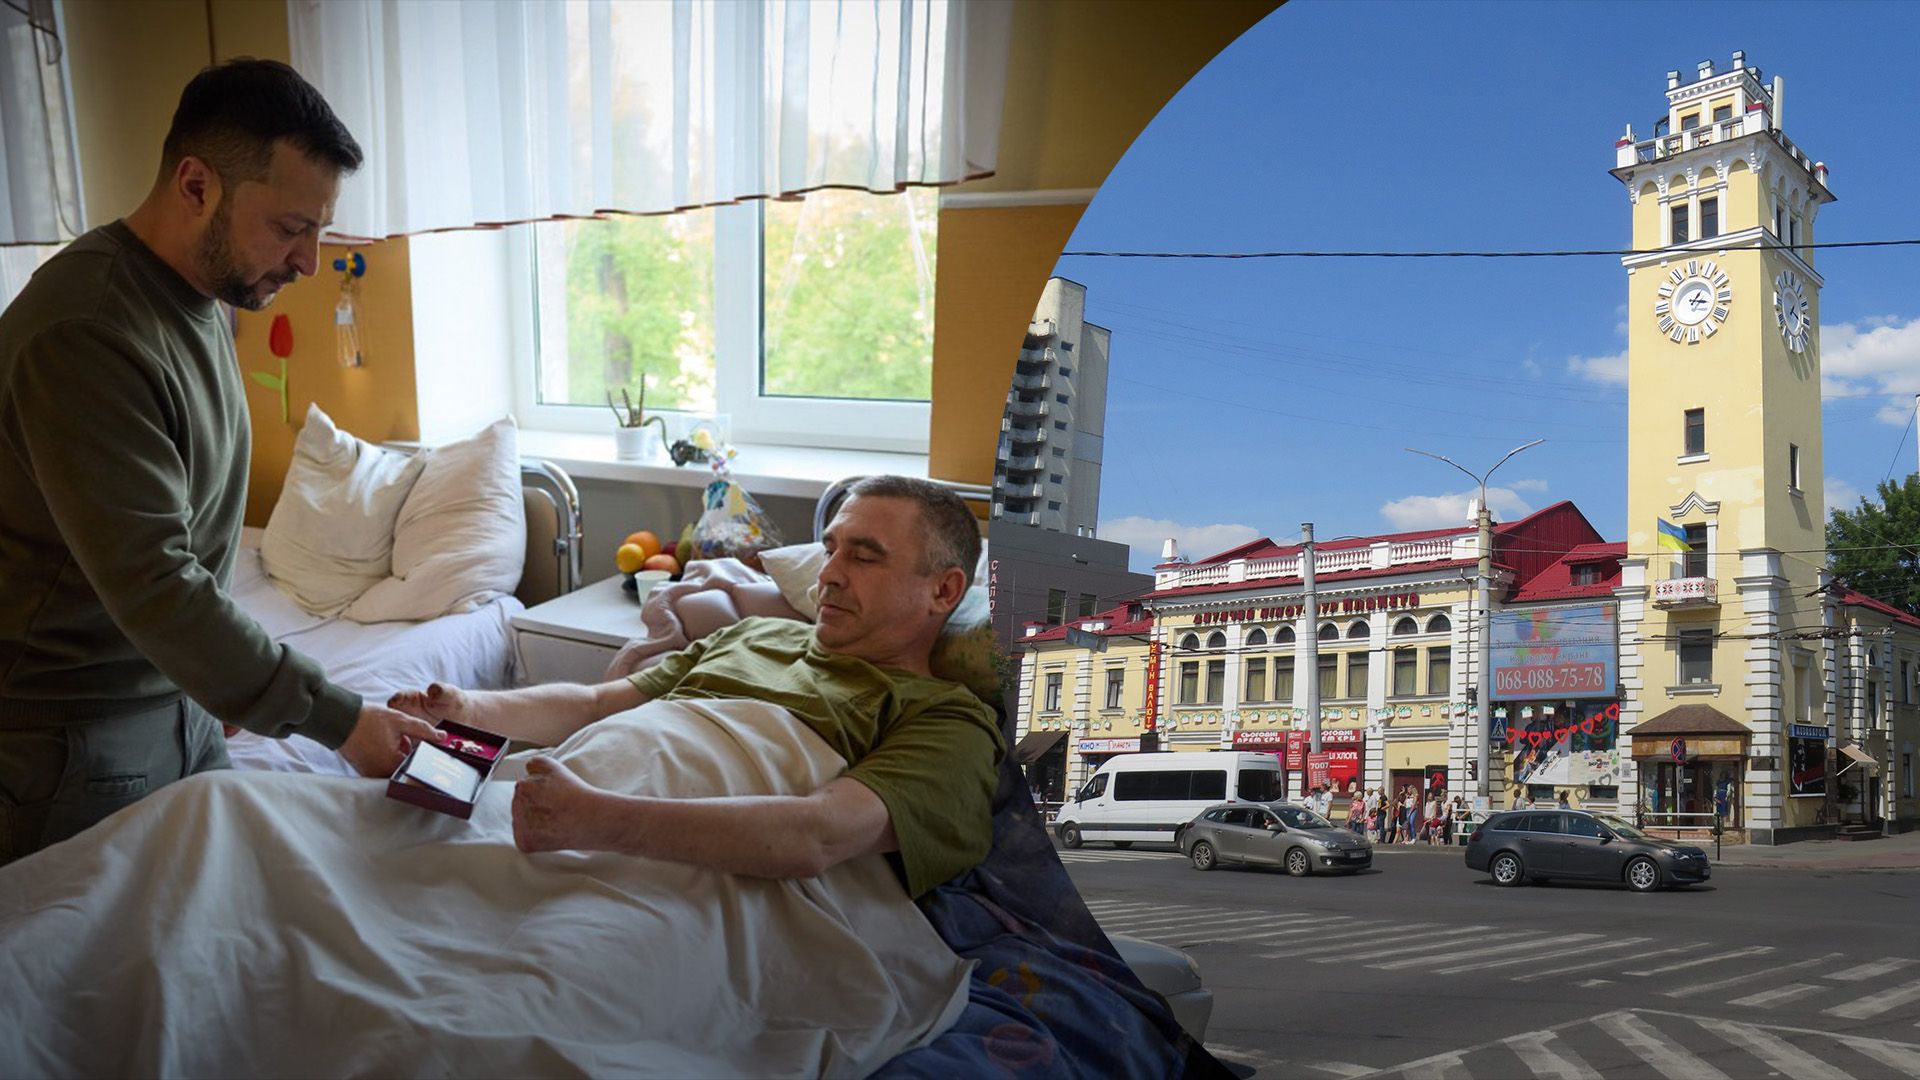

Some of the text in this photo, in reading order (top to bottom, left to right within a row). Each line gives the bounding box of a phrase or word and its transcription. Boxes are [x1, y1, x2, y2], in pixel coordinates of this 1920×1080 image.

[1260, 601, 1339, 619] КІНОТТР
[1343, 592, 1420, 612] ПЛАНЕТА
[1496, 666, 1603, 690] 068-088-75-78
[1080, 742, 1095, 750] КІНО
[1310, 762, 1329, 770] 7007
